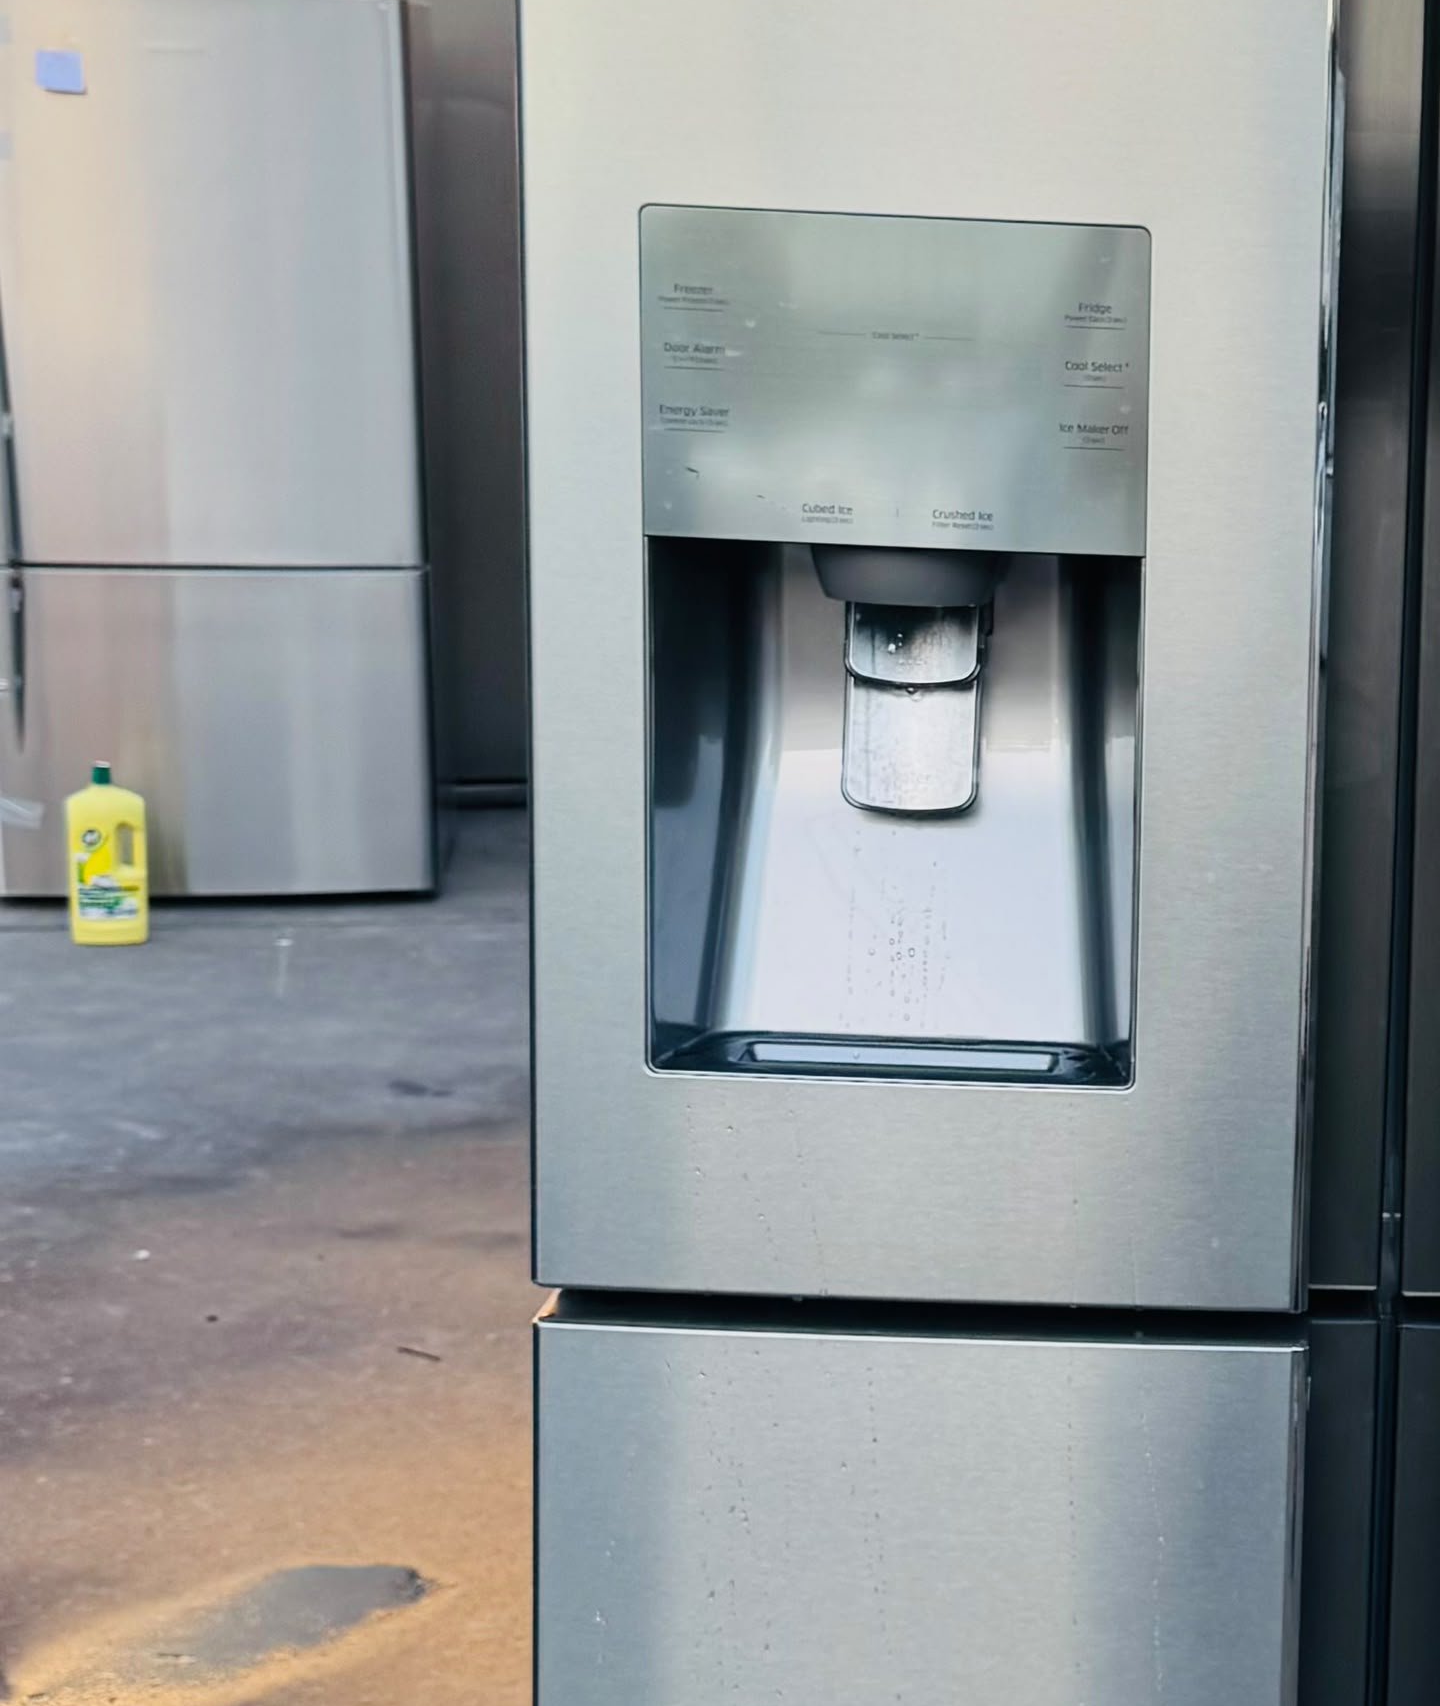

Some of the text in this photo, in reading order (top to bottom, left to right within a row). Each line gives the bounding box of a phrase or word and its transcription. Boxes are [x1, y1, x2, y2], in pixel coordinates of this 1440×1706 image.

[1077, 302, 1113, 315] Fridge
[663, 341, 690, 353] Door
[1064, 360, 1089, 372] Cool
[659, 404, 697, 417] Energy
[1059, 423, 1074, 434] Ice
[1111, 424, 1129, 436] Off
[801, 503, 836, 515] Cubed
[932, 509, 994, 522] Crushed Ice
